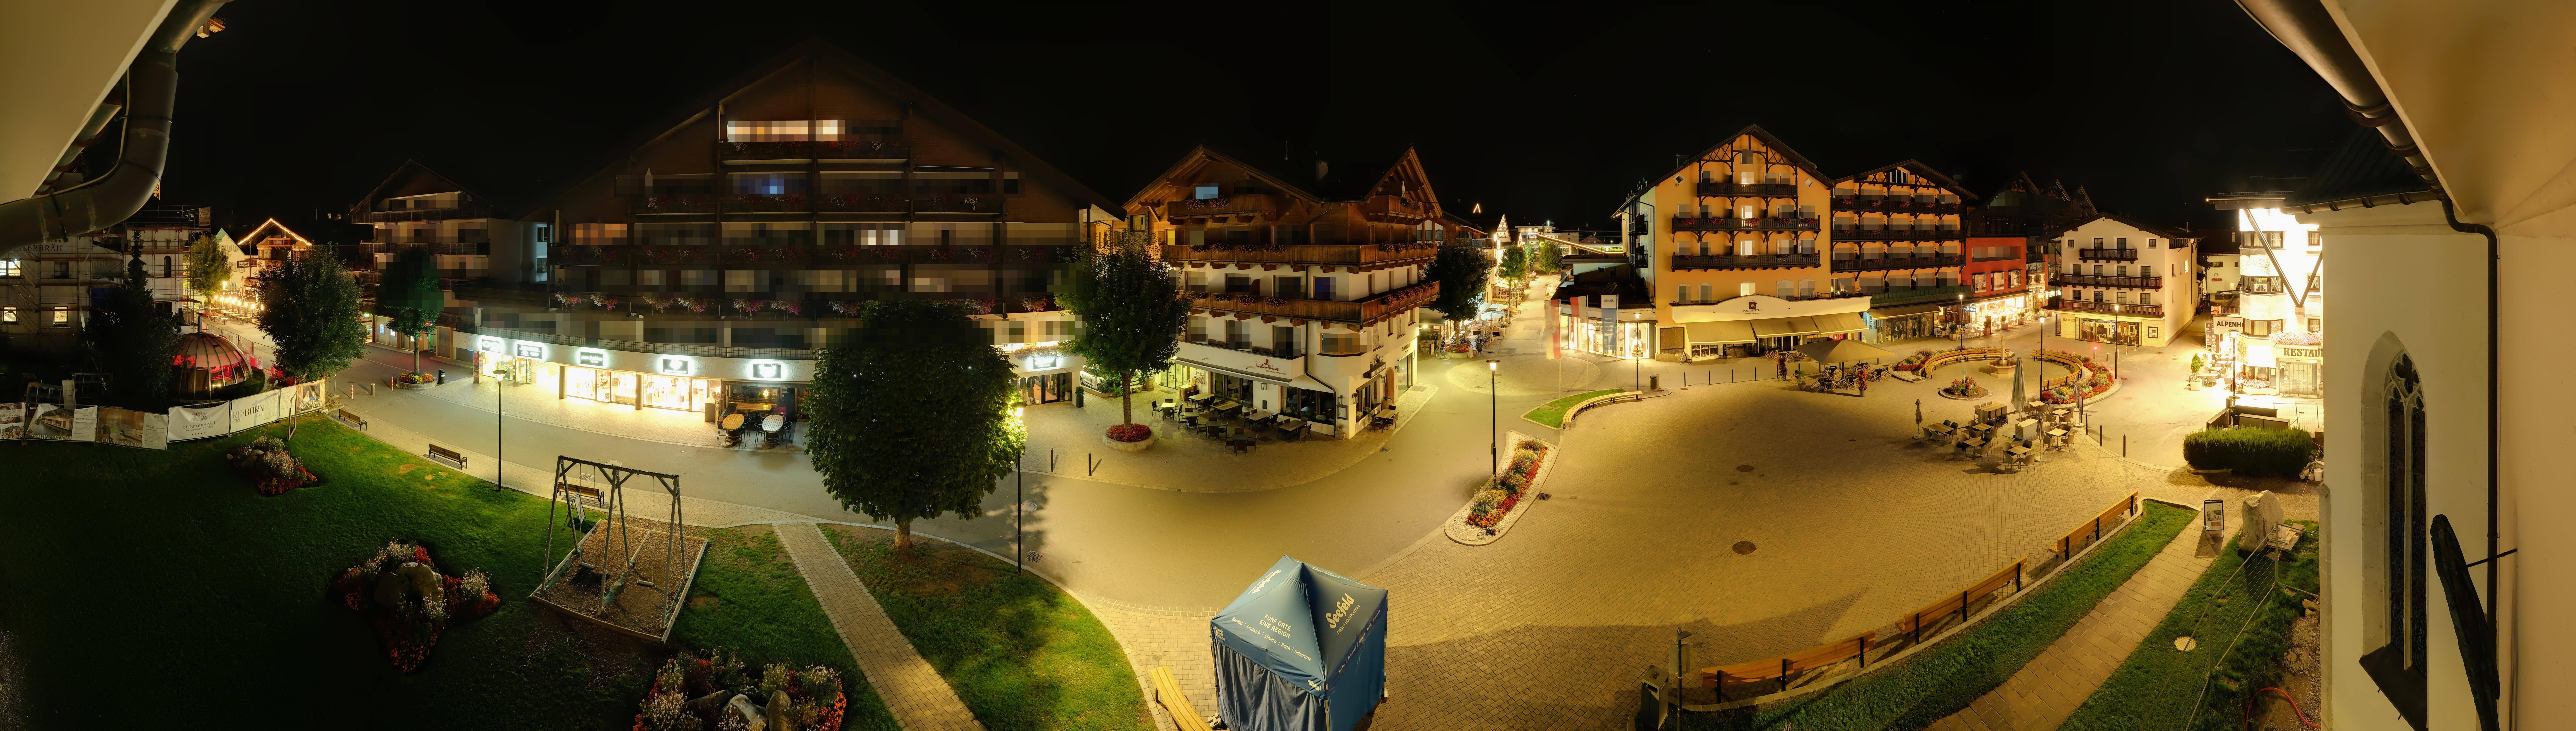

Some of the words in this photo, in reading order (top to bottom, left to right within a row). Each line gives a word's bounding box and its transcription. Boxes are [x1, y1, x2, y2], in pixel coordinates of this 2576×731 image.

[1402, 343, 1410, 351] SAILER
[1371, 364, 1386, 377] RESTAURANT
[1326, 592, 1354, 628] Seefeld
[1259, 619, 1270, 628] EINE
[1271, 625, 1291, 639] REGION
[1264, 614, 1277, 623] FÜNF
[1278, 621, 1292, 631] ORTE
[1336, 623, 1345, 635] TIROLS
[1345, 605, 1360, 624] HOCHPLATEAU
[1232, 617, 1243, 625] Seefeld
[1246, 624, 1260, 635] Leutasch
[1264, 634, 1277, 644] Mösern
[1281, 642, 1290, 651] Reith
[1294, 649, 1312, 661] Scharnitz
[1348, 645, 1357, 660] Leutasch
